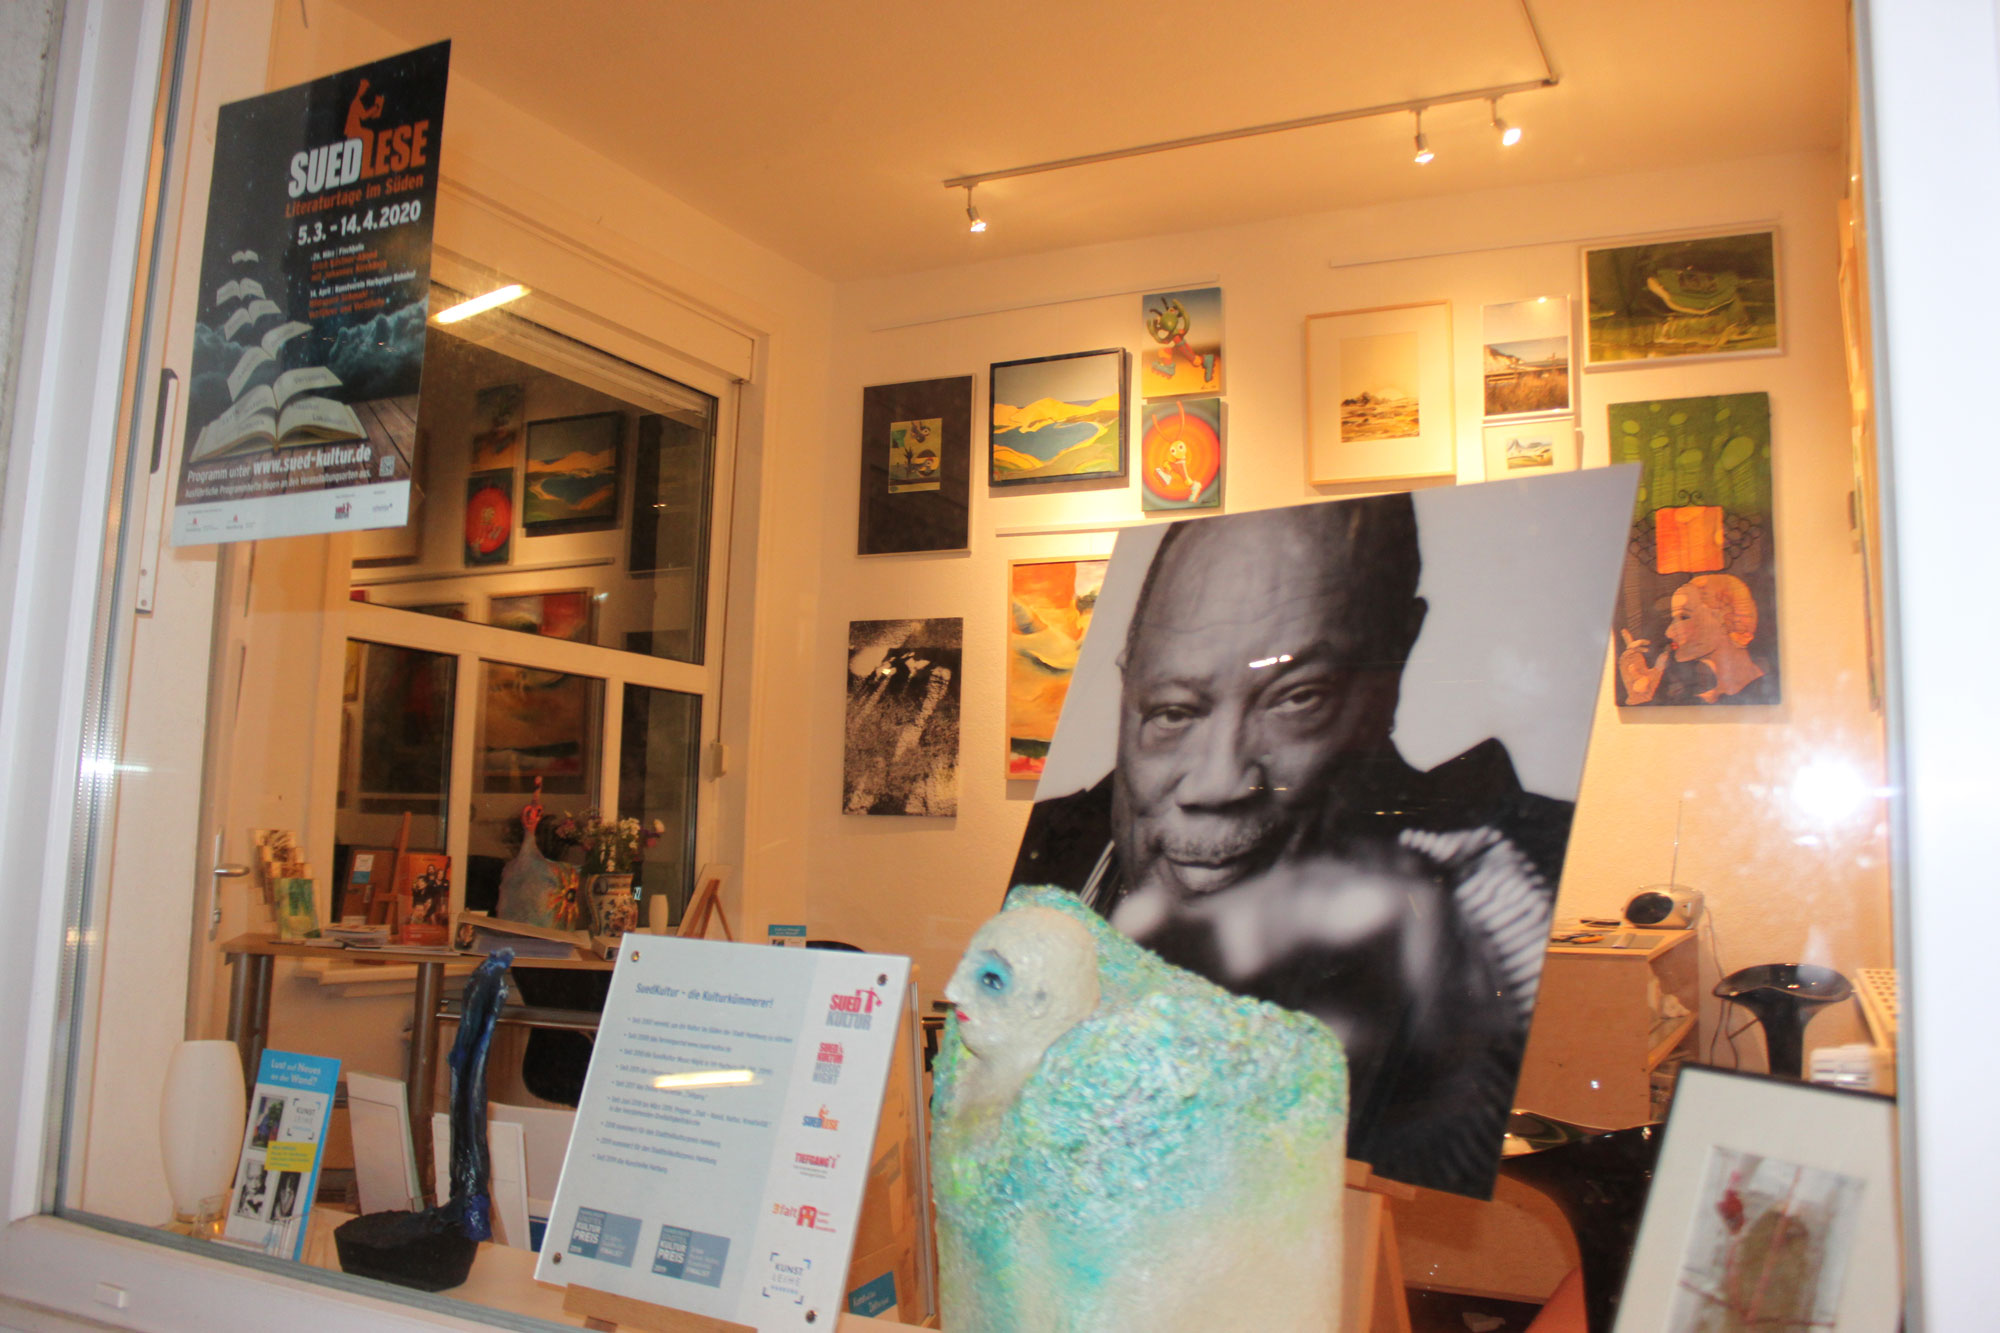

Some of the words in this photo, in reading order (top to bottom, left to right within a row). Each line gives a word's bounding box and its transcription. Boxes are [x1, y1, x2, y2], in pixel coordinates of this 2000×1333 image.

[285, 189, 363, 218] Literaturtage
[366, 183, 381, 199] im
[385, 174, 424, 195] Süden
[297, 221, 327, 246] 5.3.
[340, 199, 421, 237] 14.4.2020
[318, 286, 331, 297] April
[187, 468, 228, 484] Programm
[229, 465, 251, 479] unter
[253, 443, 373, 476] www.sued-kultur.de
[636, 982, 680, 998] SuedKultur
[687, 989, 700, 1000] die
[829, 994, 862, 1013] SUED
[826, 1011, 872, 1031] KULTUR
[271, 1059, 287, 1069] Lust
[573, 1229, 599, 1244] PREIS
[656, 1248, 685, 1264] PREIS
[775, 1263, 804, 1276] KUNST
